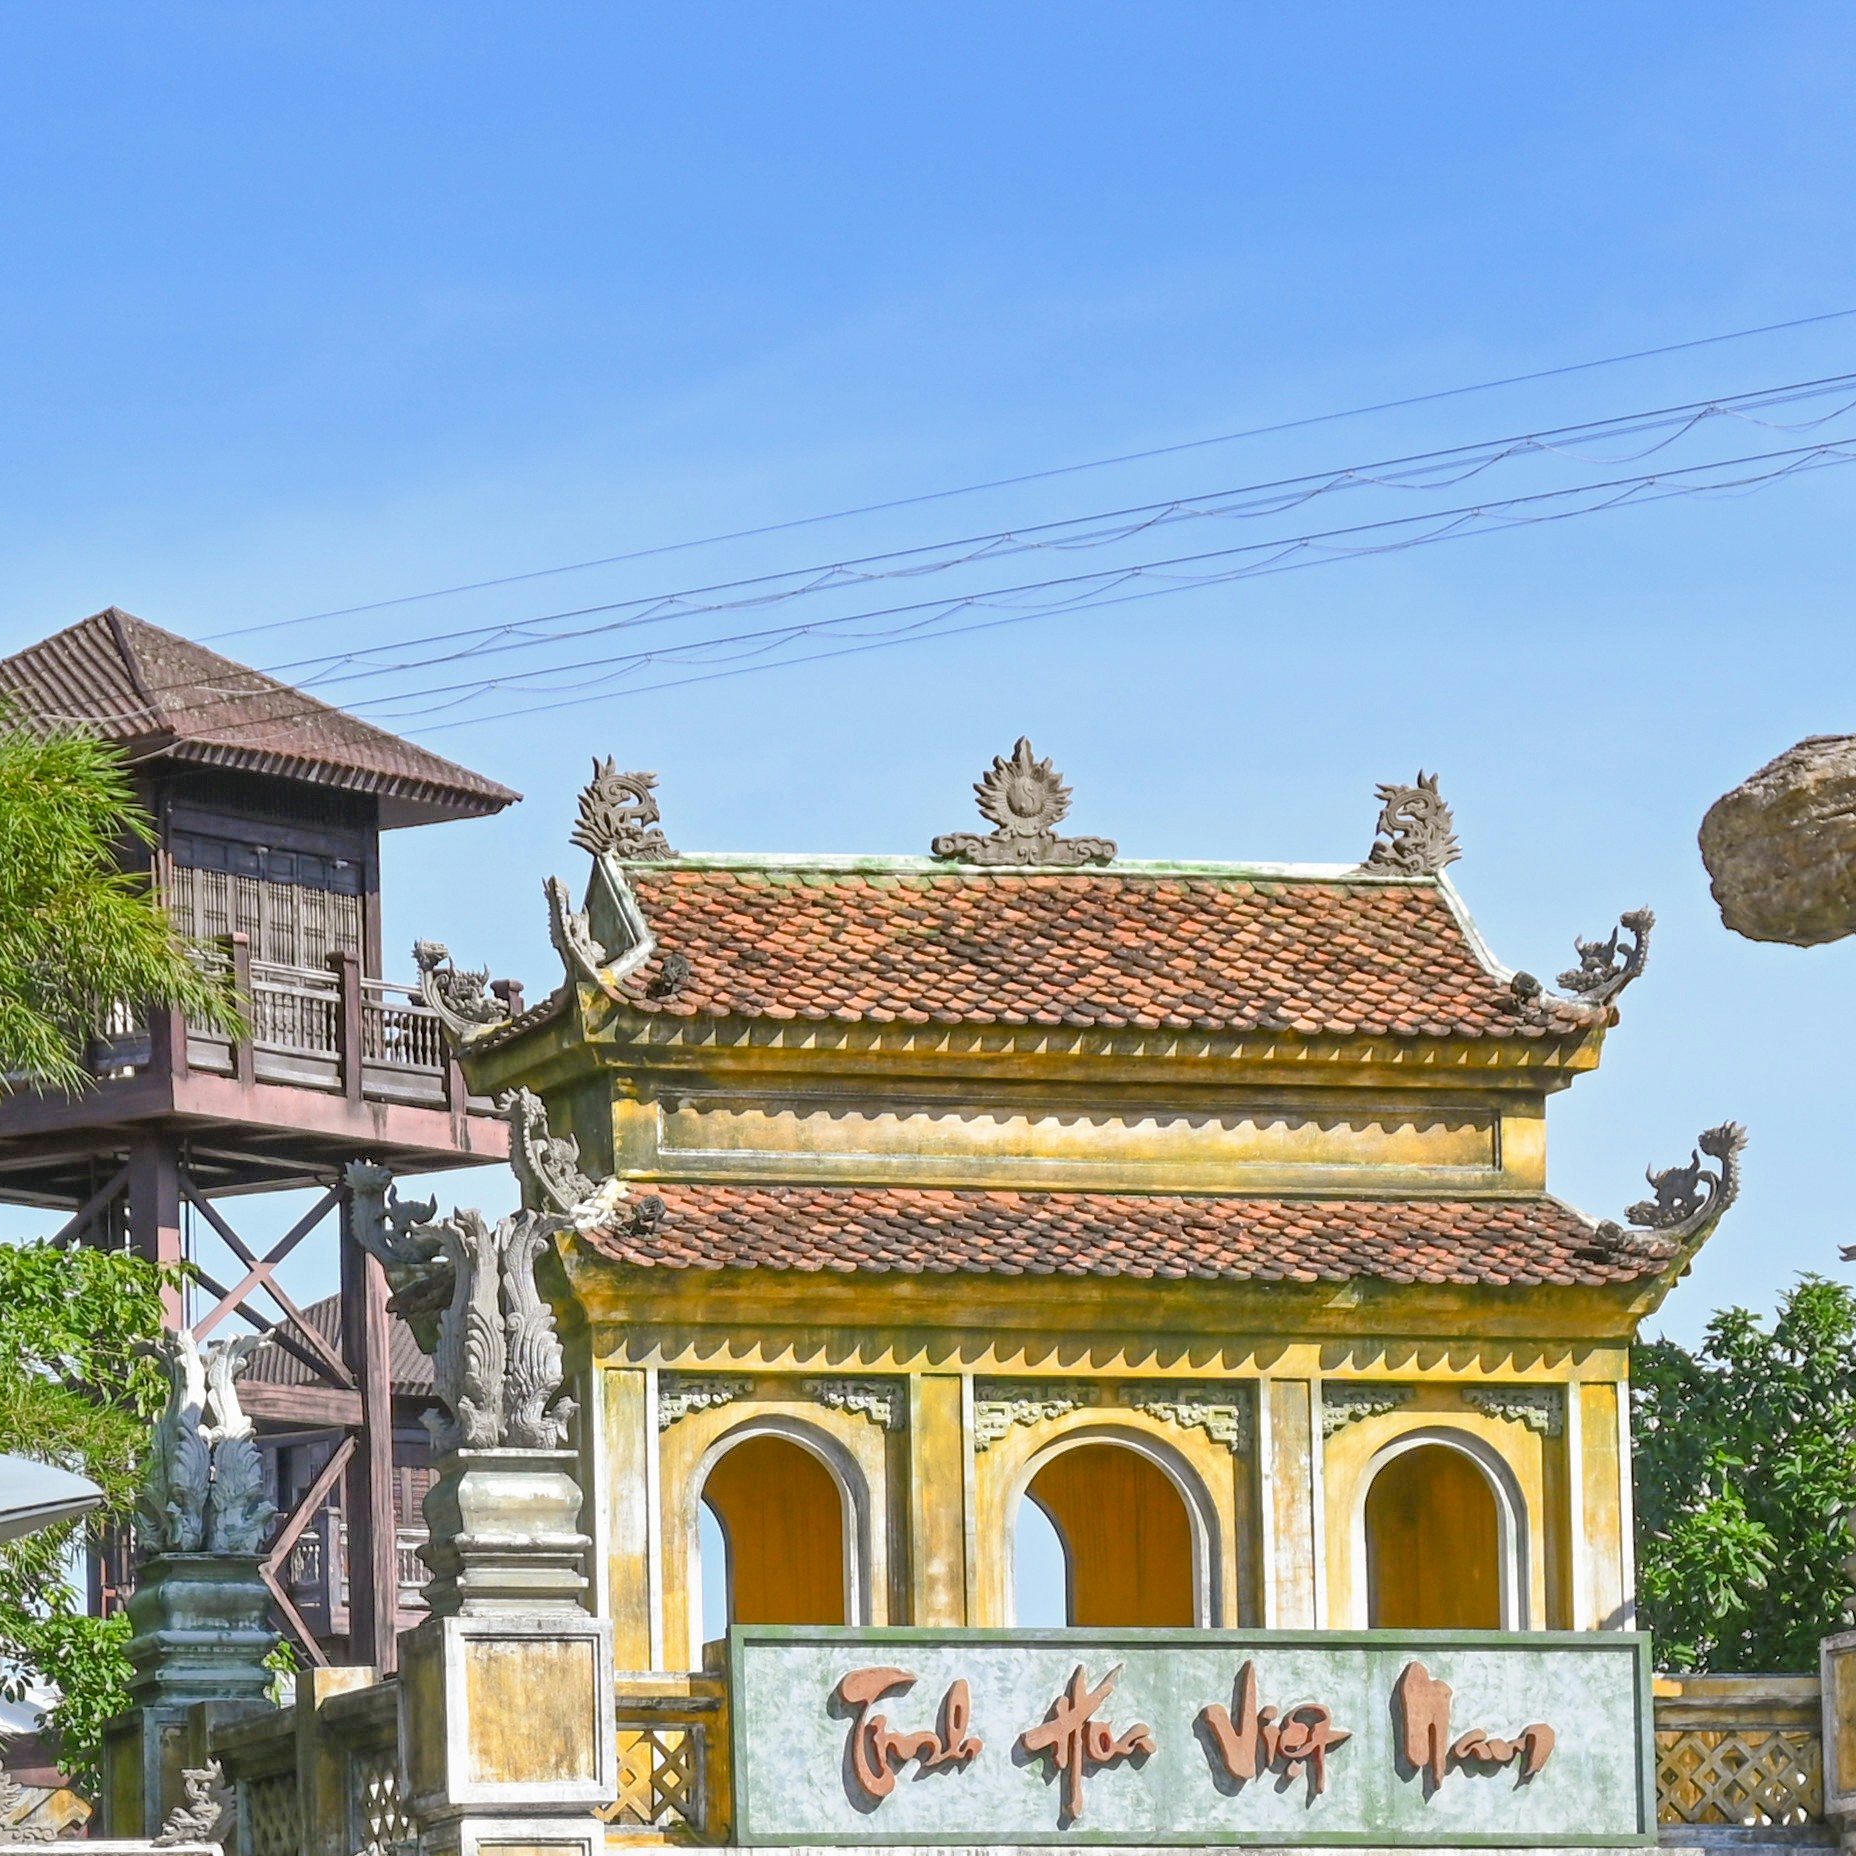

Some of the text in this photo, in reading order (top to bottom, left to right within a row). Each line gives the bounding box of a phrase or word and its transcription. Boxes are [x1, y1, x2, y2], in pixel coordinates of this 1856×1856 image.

[1022, 1662, 1158, 1820] Hoa
[1202, 1659, 1352, 1796] Việt
[1398, 1660, 1556, 1792] Nam
